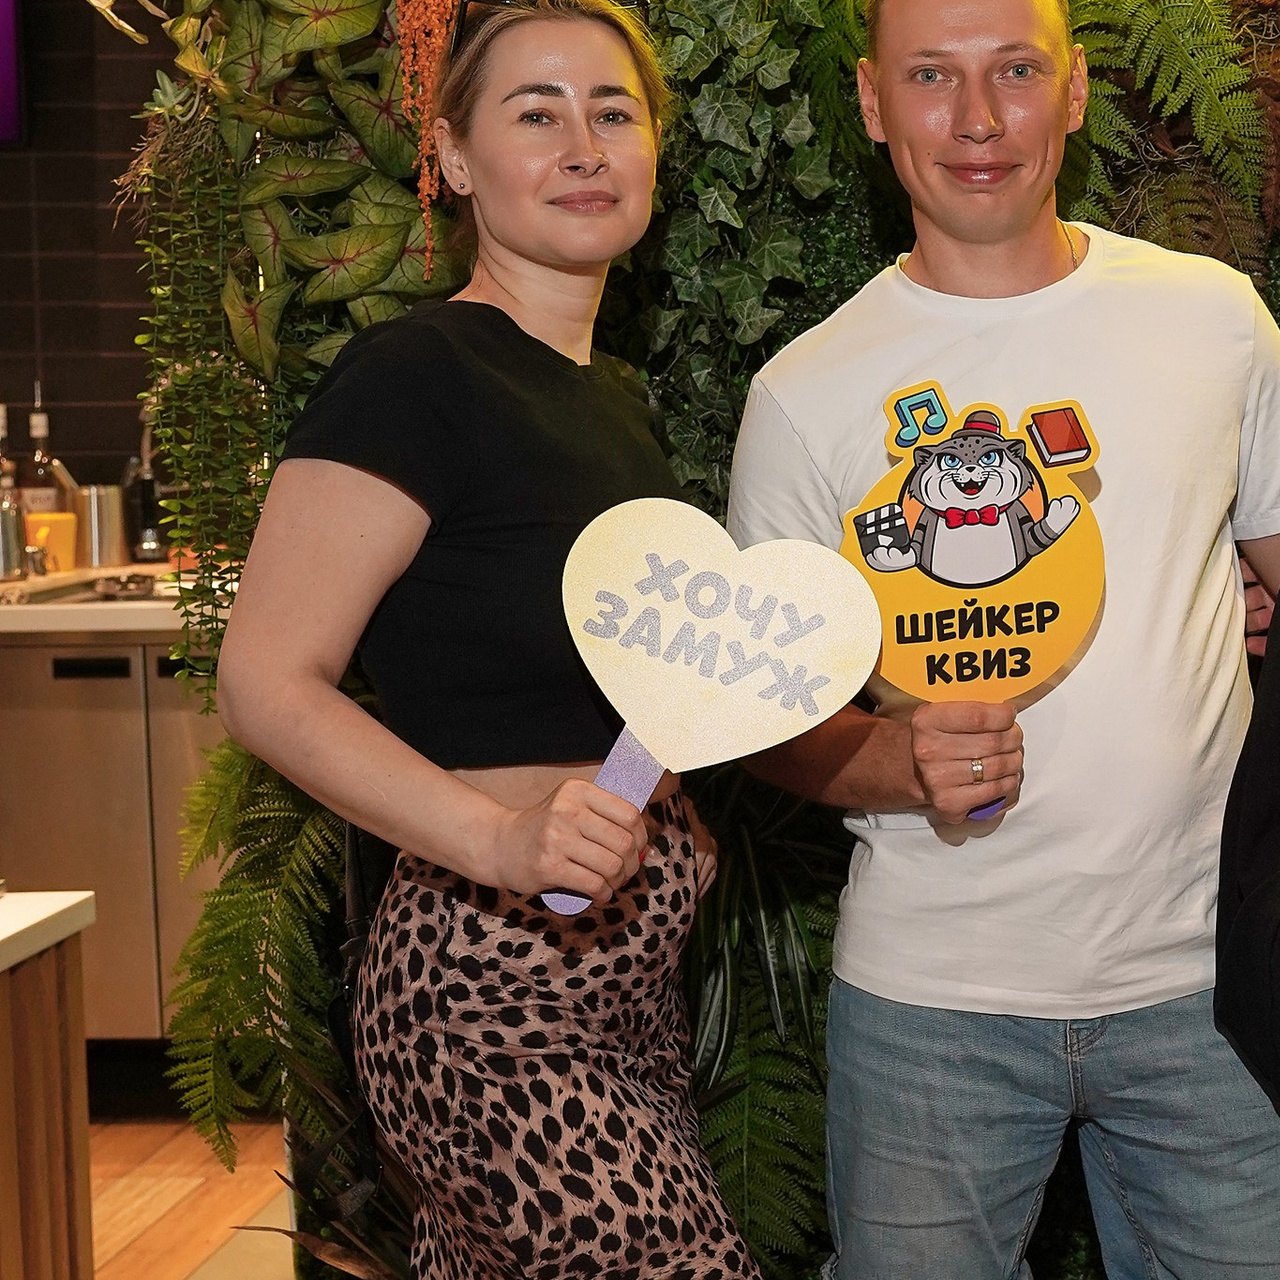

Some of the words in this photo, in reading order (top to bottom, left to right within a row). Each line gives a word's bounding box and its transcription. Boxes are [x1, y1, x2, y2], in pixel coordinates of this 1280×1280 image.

[634, 552, 826, 648] ХОЧУ
[895, 598, 1060, 645] ШЕЙКЕР
[582, 589, 831, 717] ЗАМУЖ
[926, 647, 1032, 686] КВИЗ
